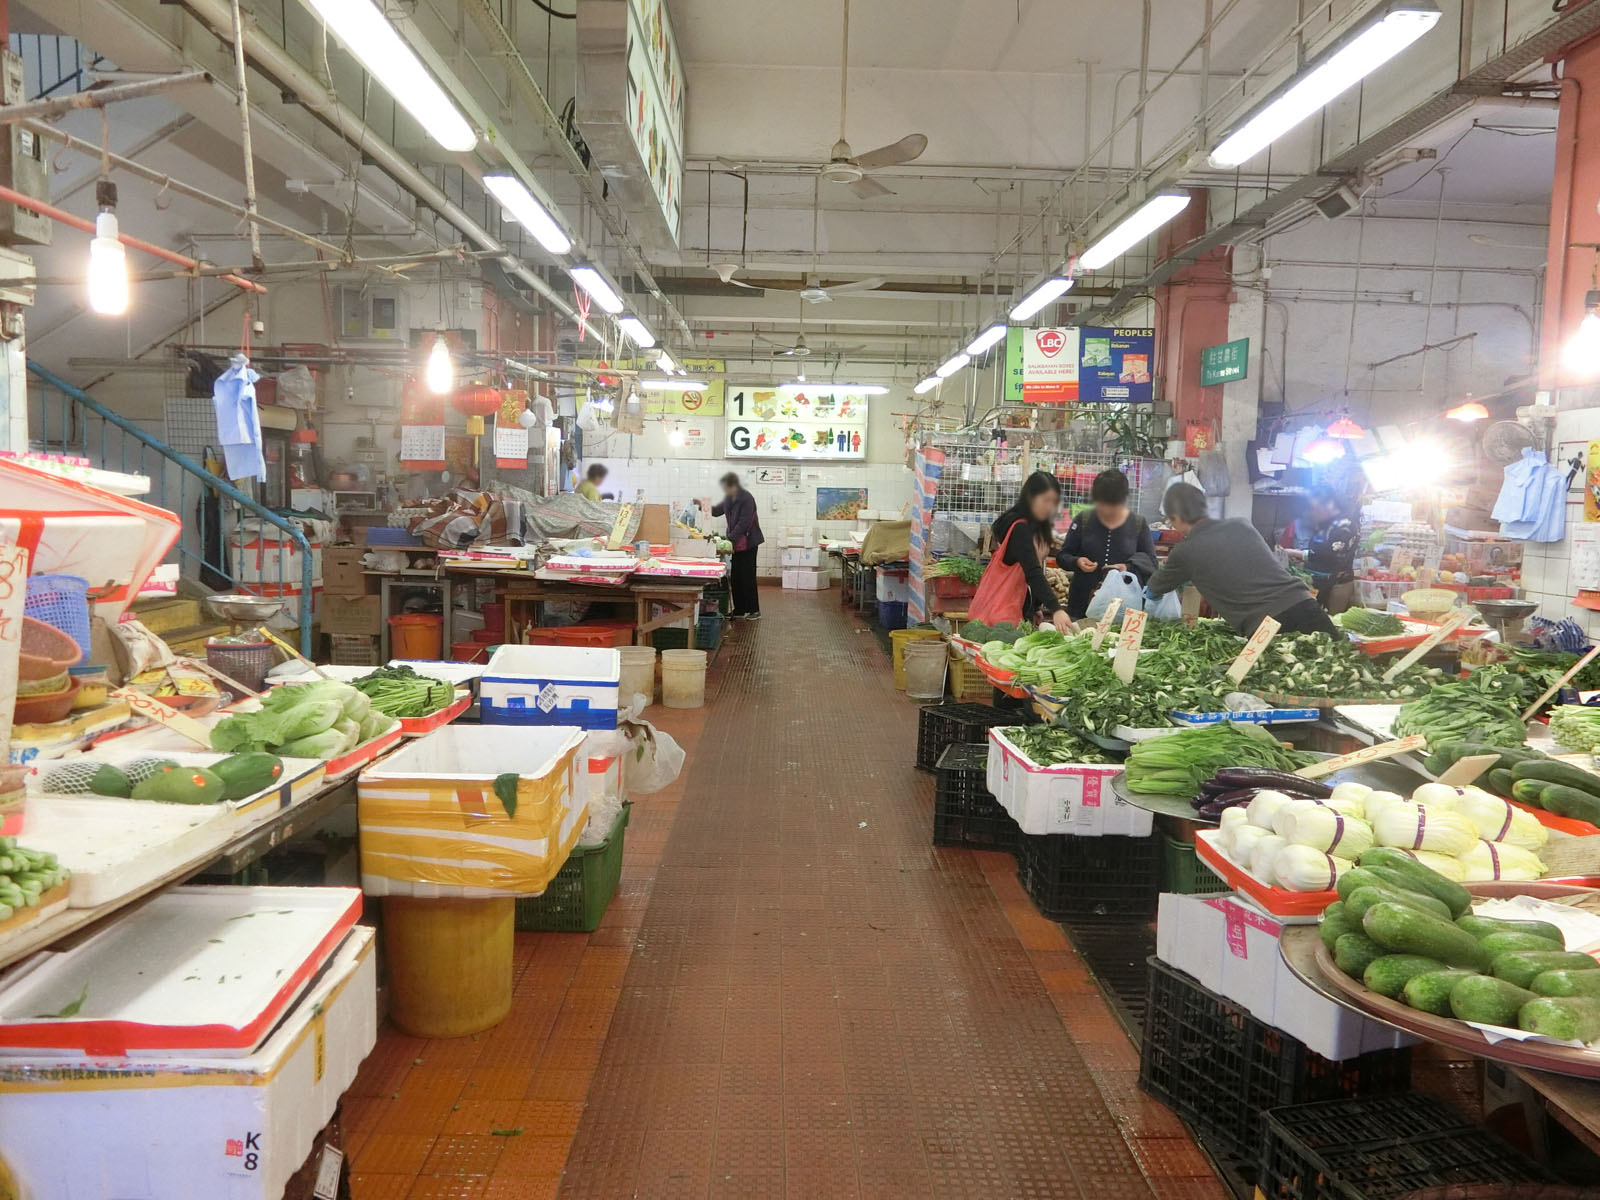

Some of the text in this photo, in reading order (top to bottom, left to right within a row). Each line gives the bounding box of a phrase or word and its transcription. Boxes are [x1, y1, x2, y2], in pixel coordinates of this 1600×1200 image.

[1113, 329, 1153, 337] PEOPLES
[1040, 339, 1062, 348] LBC
[1225, 364, 1240, 376] Street
[733, 392, 744, 416] 1
[730, 425, 751, 451] G
[620, 509, 629, 519] 13
[1123, 617, 1141, 634] 12
[1251, 625, 1271, 644] 10
[245, 1131, 262, 1151] K
[244, 1152, 259, 1171] 8
